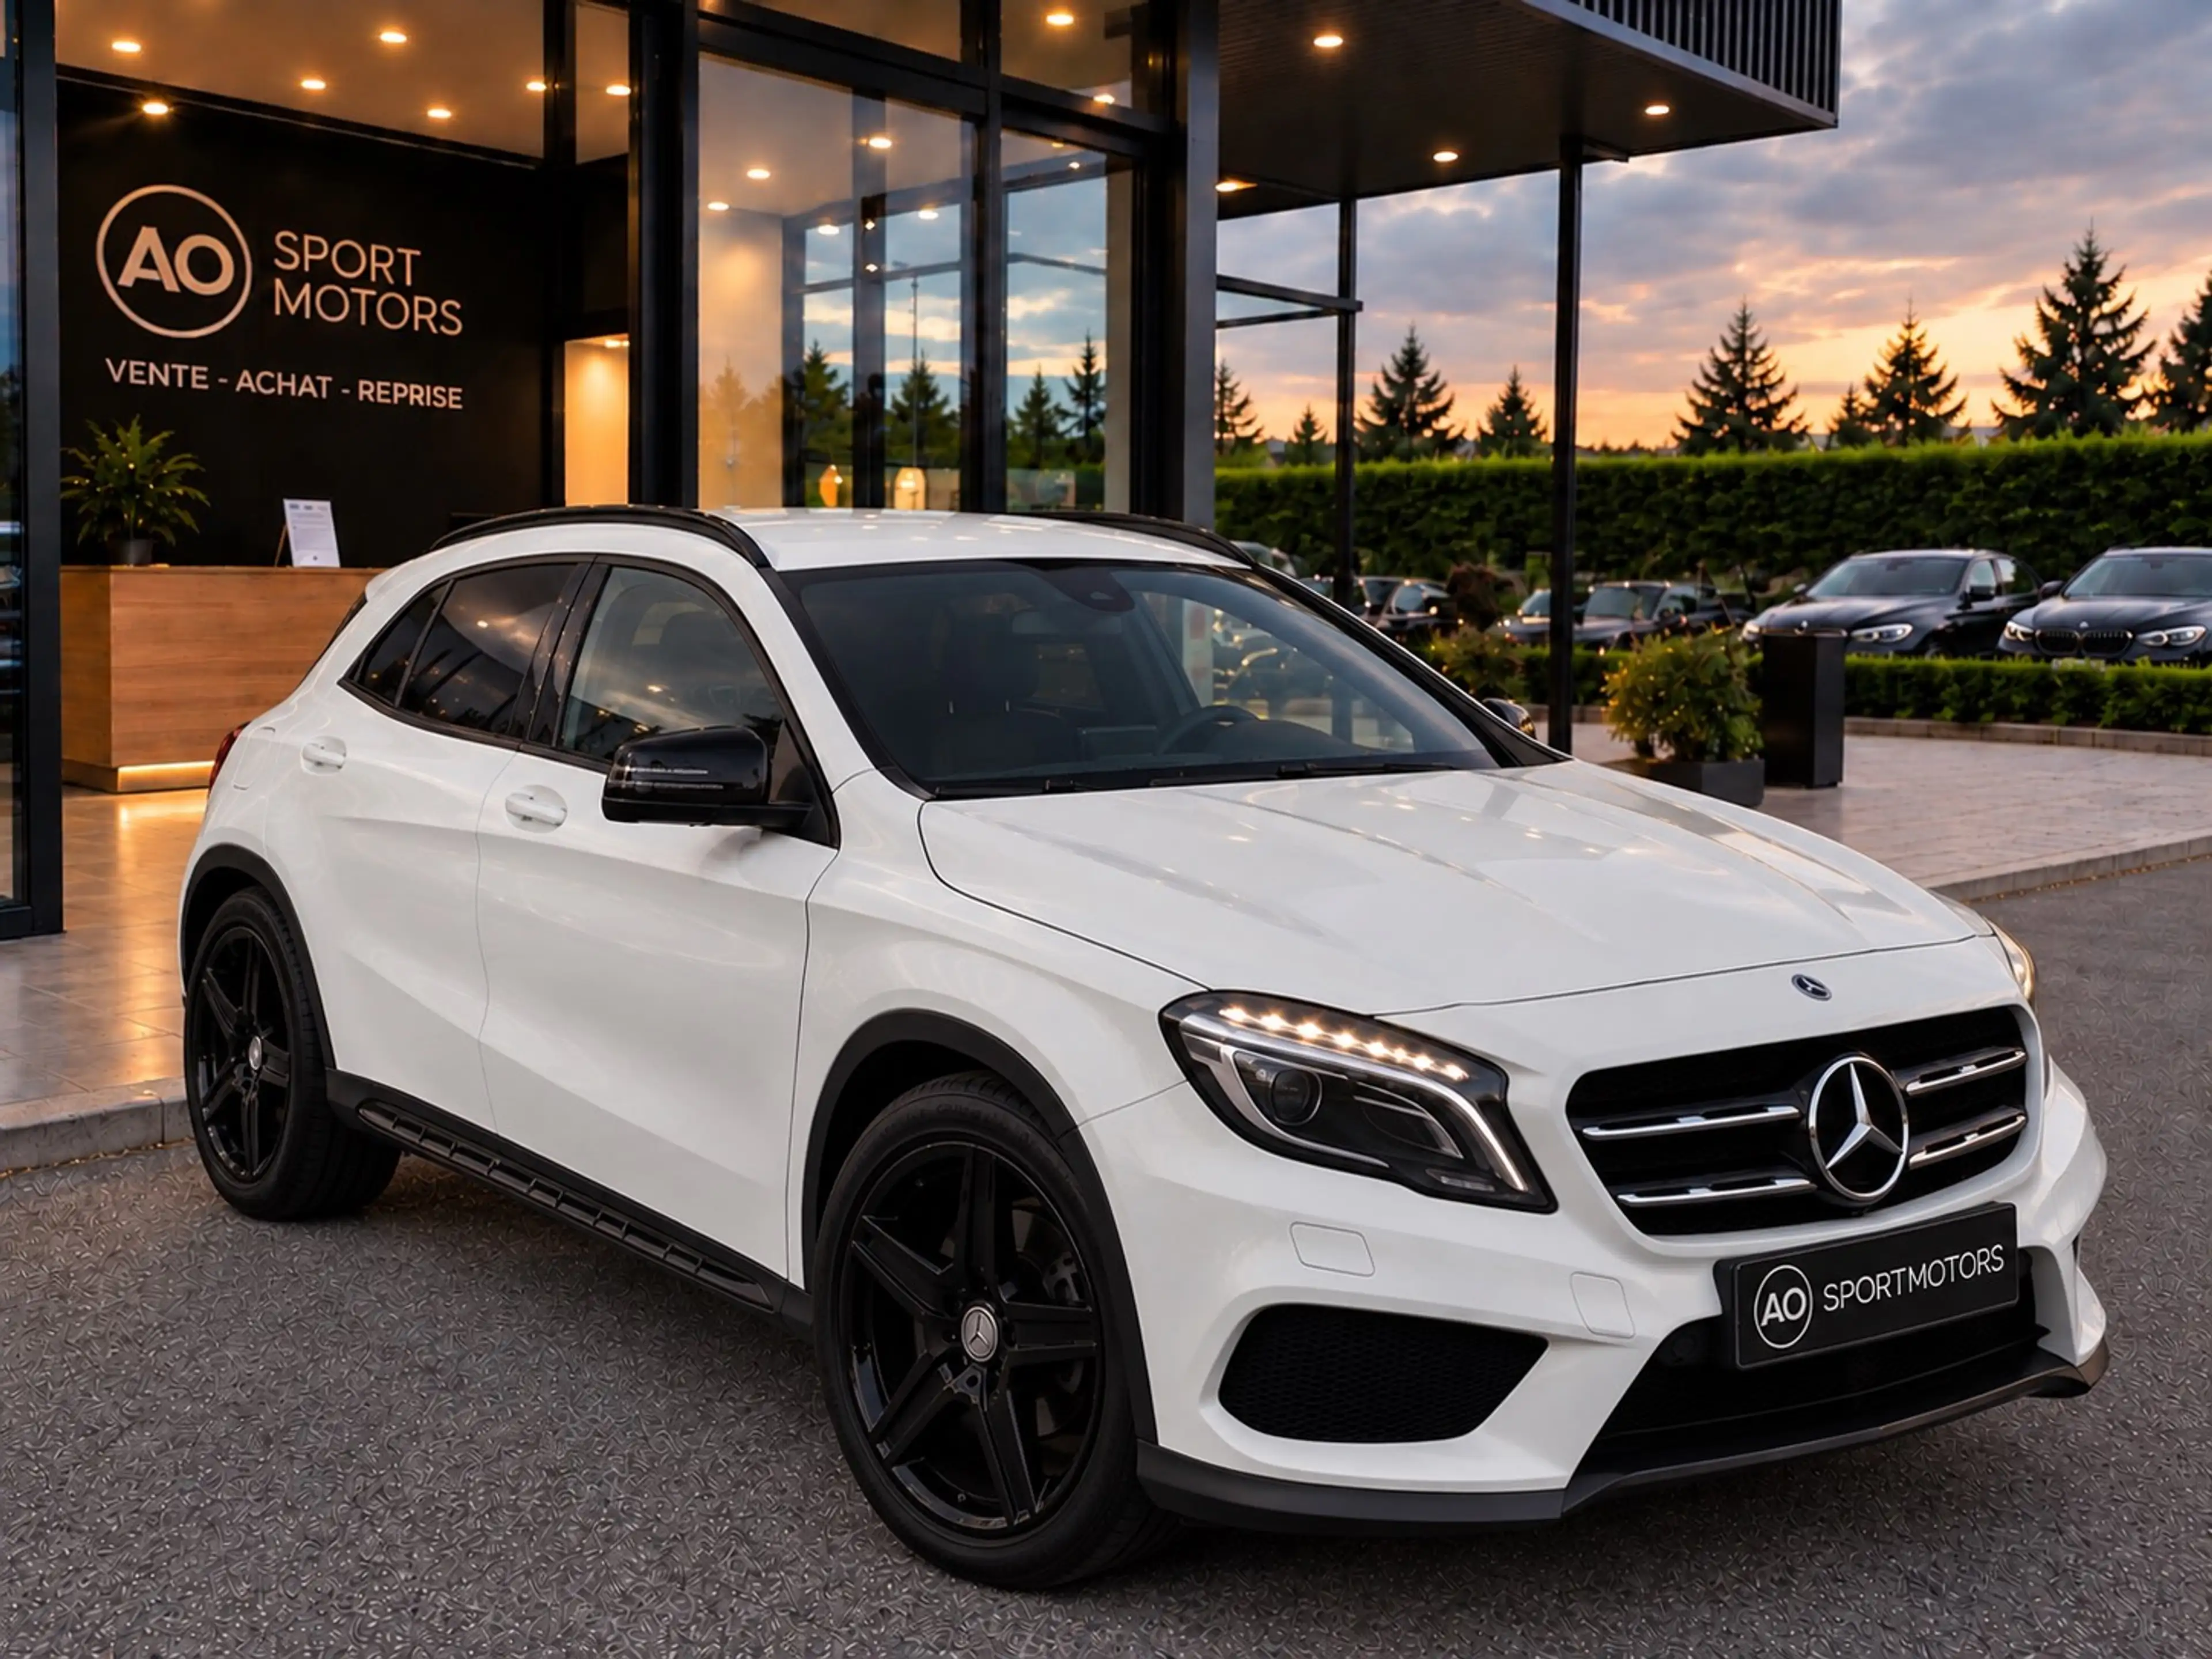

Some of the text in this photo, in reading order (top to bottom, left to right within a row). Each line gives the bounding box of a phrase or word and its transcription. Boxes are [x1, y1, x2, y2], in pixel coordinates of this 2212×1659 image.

[117, 225, 235, 296] AO
[274, 230, 421, 285] SPORT
[275, 278, 464, 336] MOTORS
[105, 358, 209, 389] VENTE
[235, 369, 332, 399] ACHAT
[358, 380, 463, 409] REPRISE
[1760, 1244, 2005, 1327] AO SPORTMOTORS
